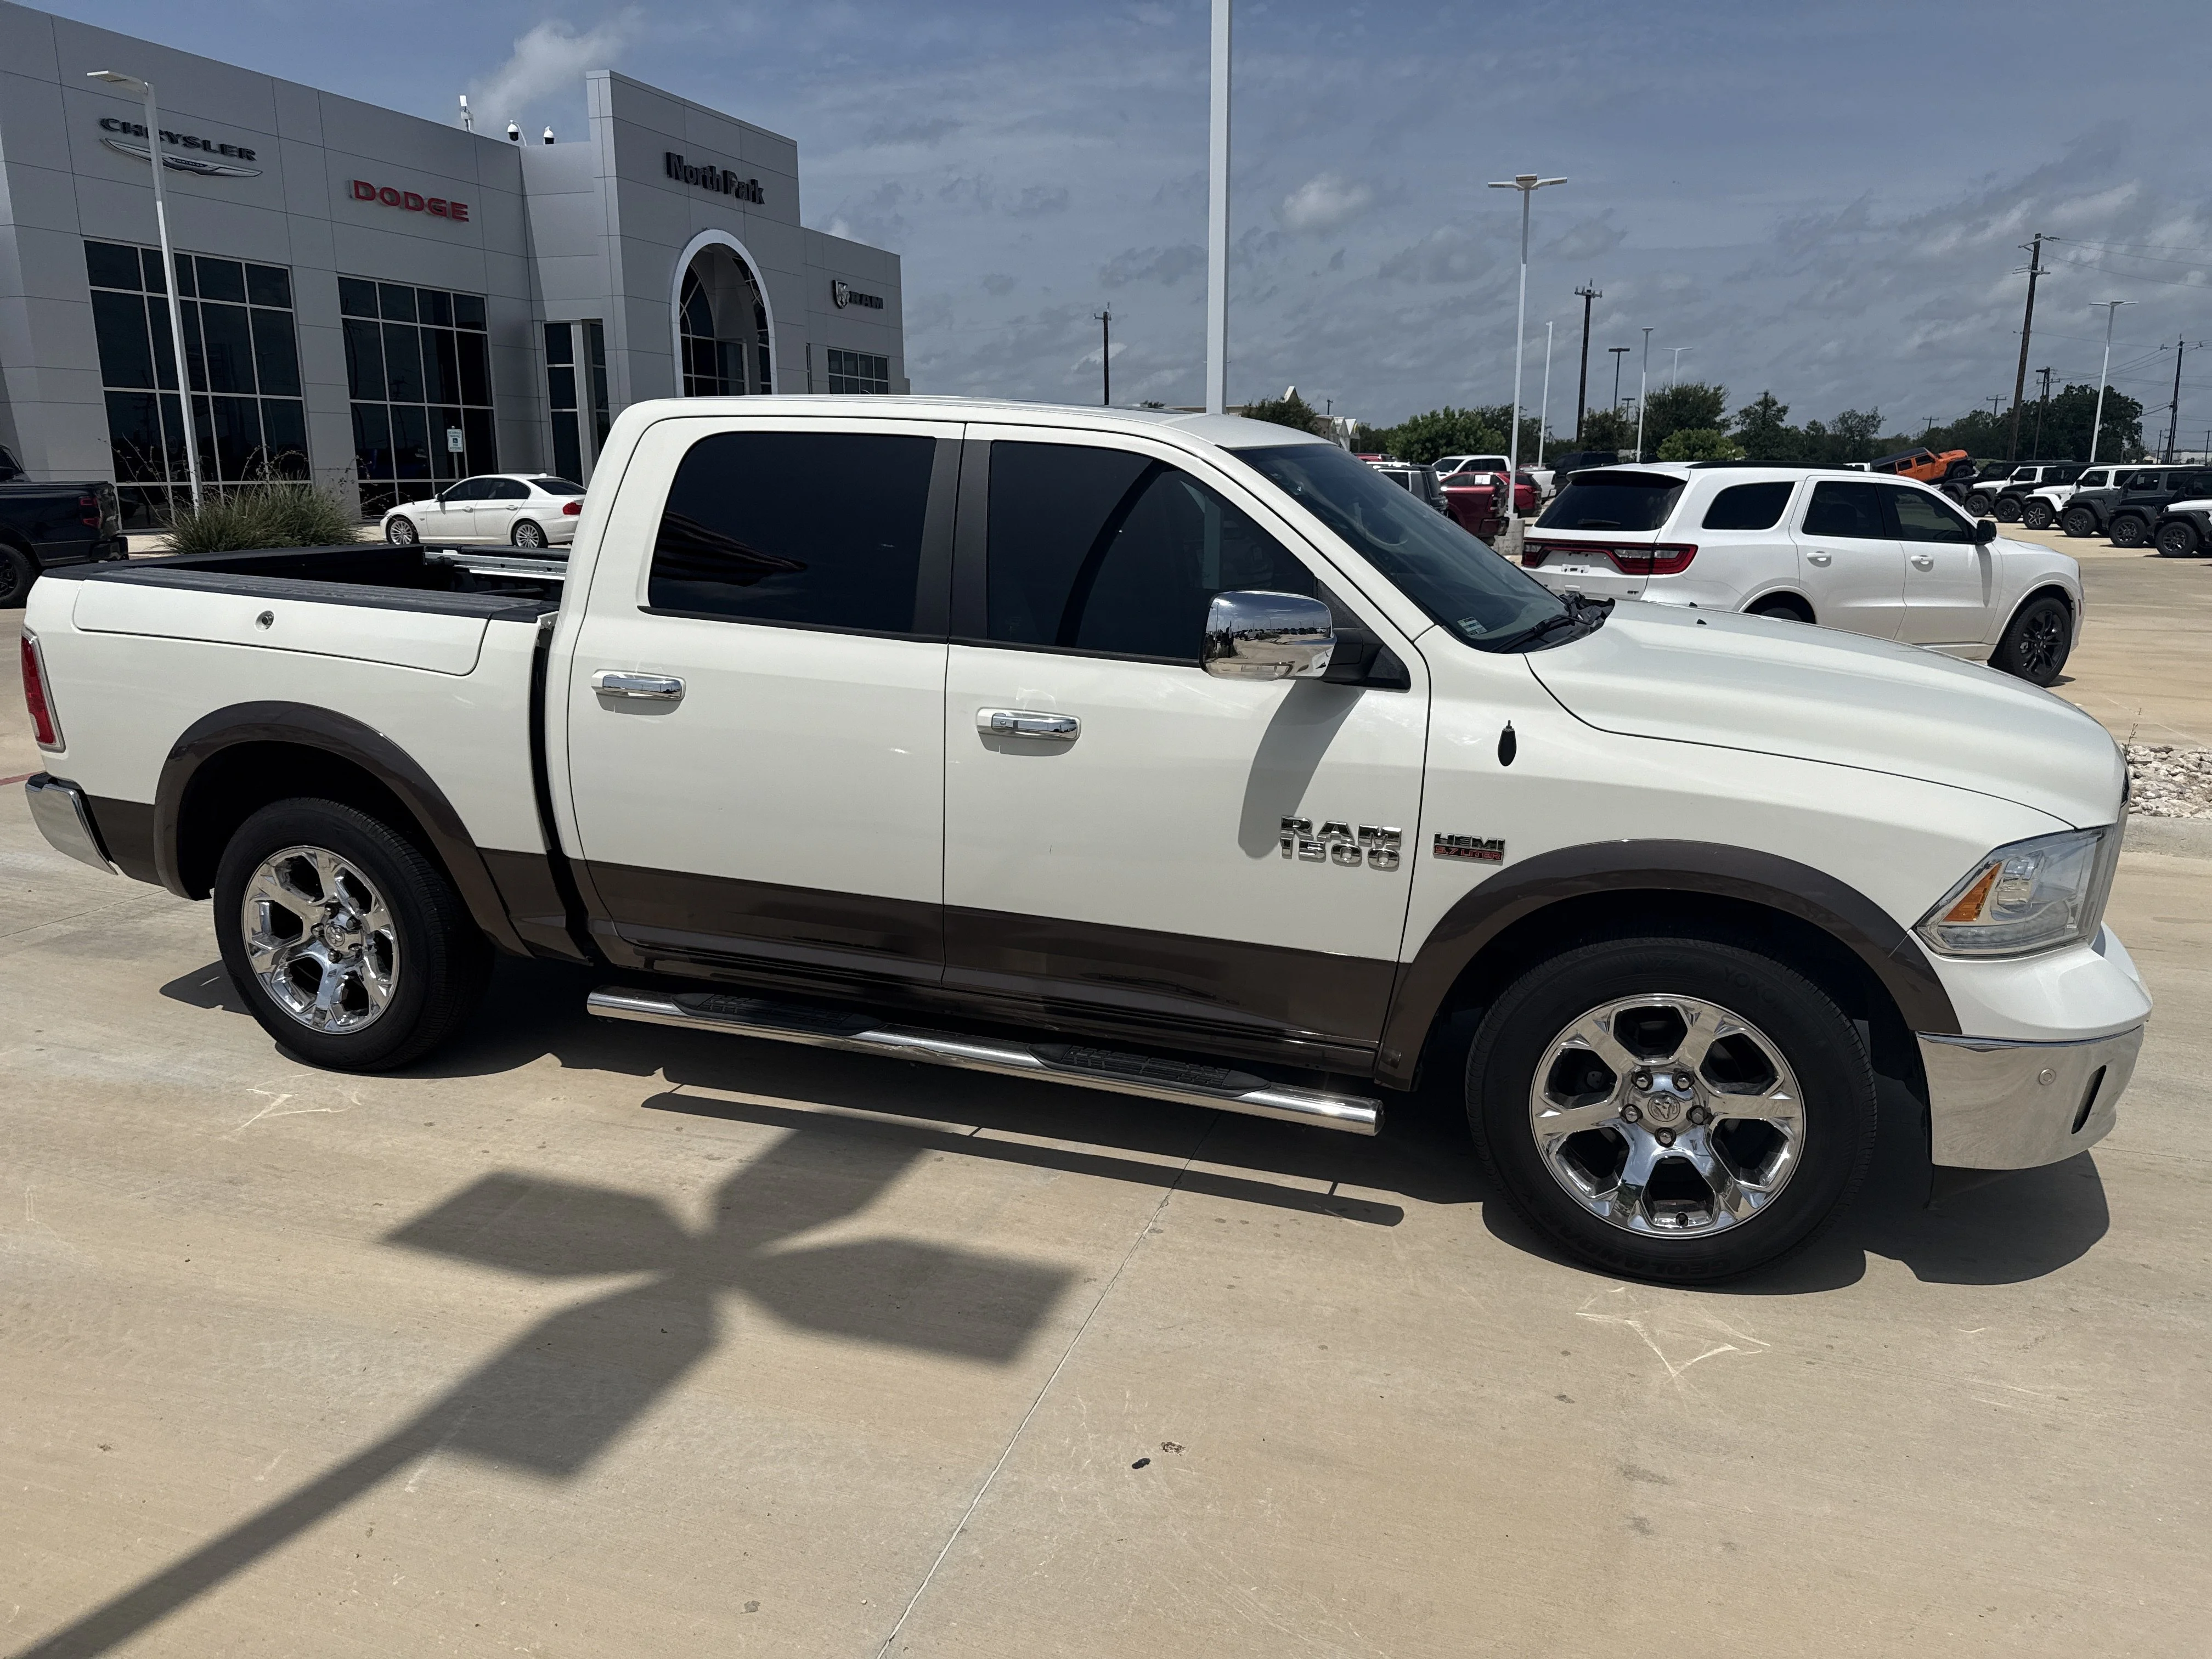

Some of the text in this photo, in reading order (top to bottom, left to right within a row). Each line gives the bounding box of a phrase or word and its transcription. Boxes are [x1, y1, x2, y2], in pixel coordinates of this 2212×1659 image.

[666, 152, 765, 204] North Park
[352, 180, 470, 222] DODGE
[848, 291, 884, 310] RAM
[1280, 815, 1402, 850] RAM
[1434, 832, 1505, 851] HEMI
[1280, 837, 1400, 872] 1500
[1435, 845, 1501, 860] 5.7 LITER
